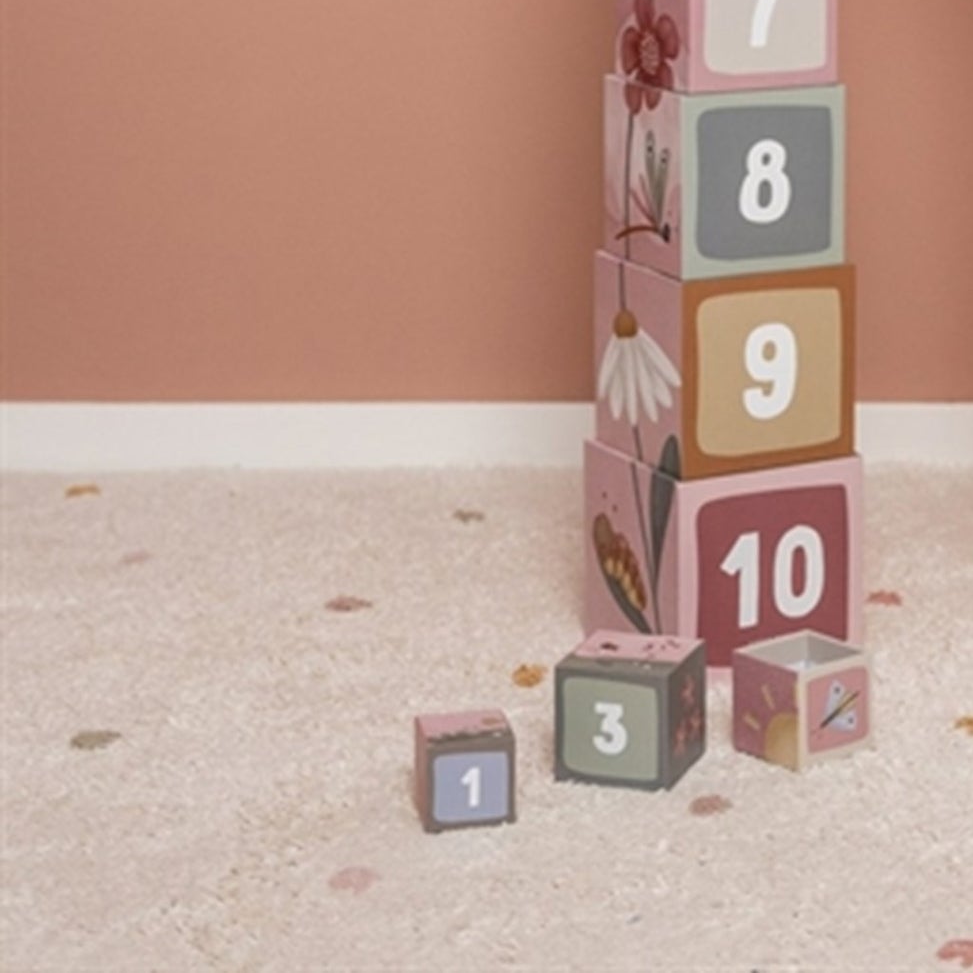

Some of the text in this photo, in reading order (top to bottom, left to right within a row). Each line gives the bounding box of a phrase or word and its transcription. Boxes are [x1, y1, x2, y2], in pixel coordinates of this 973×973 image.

[737, 137, 792, 225] 8
[741, 321, 799, 421] 9
[719, 523, 826, 630] 10
[592, 702, 628, 756] 3
[460, 766, 482, 808] 1
